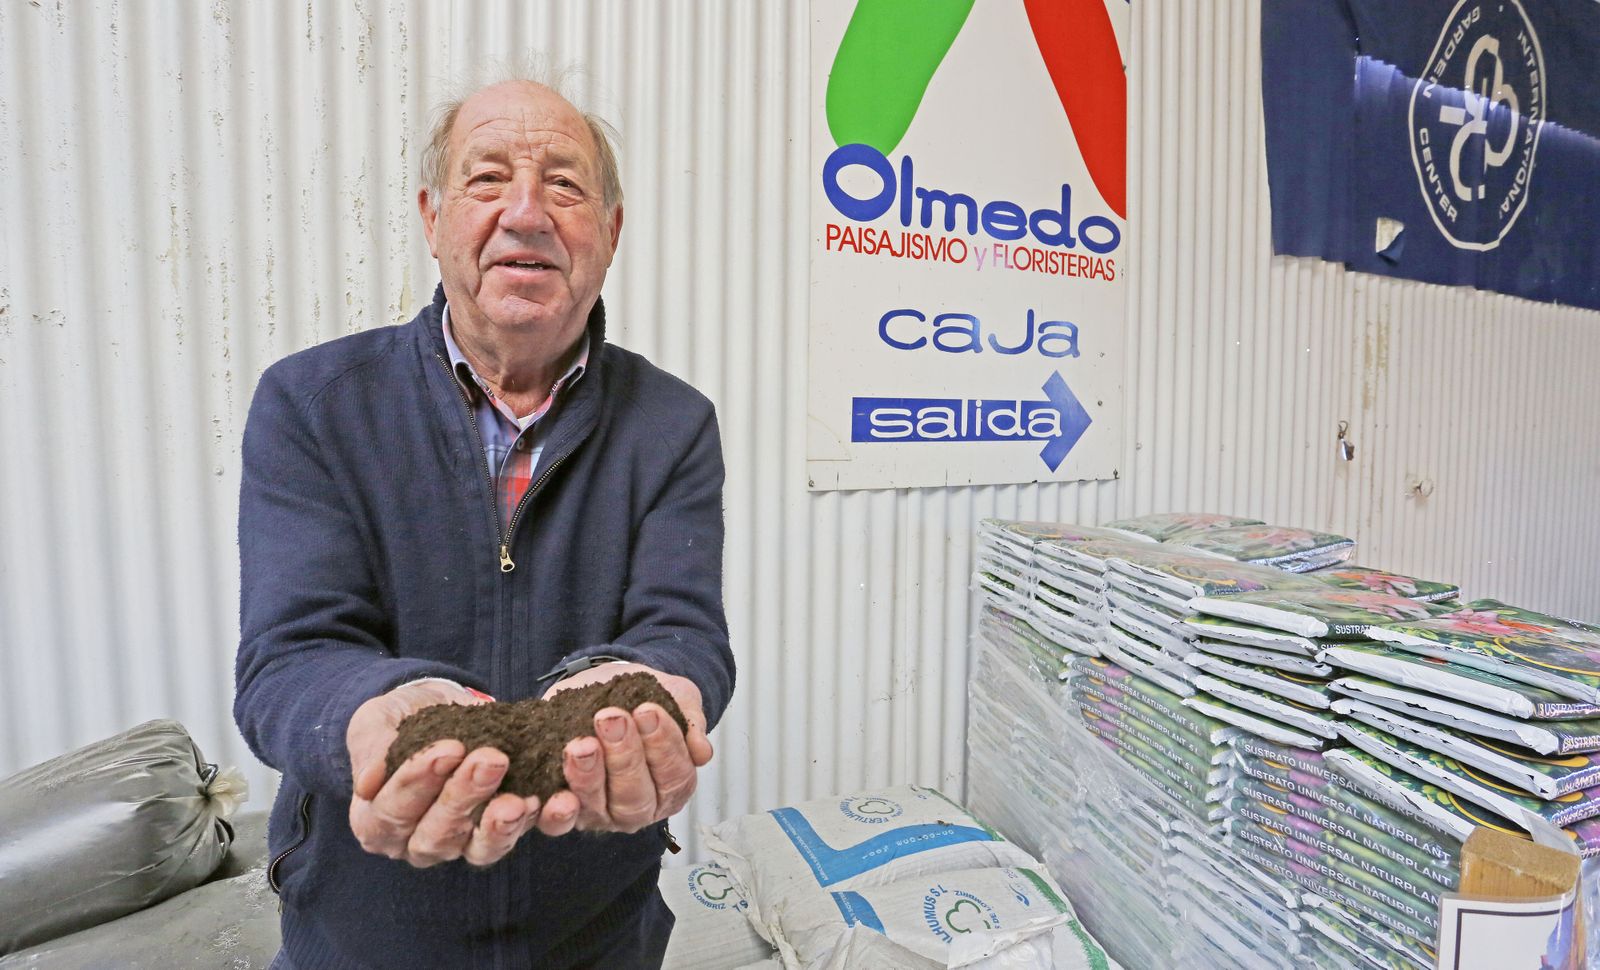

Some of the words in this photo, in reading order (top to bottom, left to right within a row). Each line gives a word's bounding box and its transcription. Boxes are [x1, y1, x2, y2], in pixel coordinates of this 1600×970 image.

[1423, 6, 1480, 98] GARDEN
[823, 143, 1121, 254] Olmedo
[1420, 127, 1458, 223] CENTER
[826, 224, 968, 263] PAISAJISMO
[973, 246, 987, 271] y
[993, 243, 1115, 282] FLORISTERIAS
[869, 399, 1062, 438] salida
[1141, 714, 1187, 745] NATURPLANT
[1142, 694, 1187, 725] NATURPLANT
[1137, 731, 1183, 760] NATURPLANT
[1244, 744, 1296, 767] SUSTRATO
[1298, 760, 1361, 794] UNIVERSAL
[1240, 808, 1293, 836] SUSTRATO
[1295, 830, 1360, 867] UNIVERSAL
[1242, 786, 1295, 813] SUSTRATO
[1297, 807, 1361, 843] UNIVERSAL
[1363, 837, 1452, 886] NATURPLANT
[1243, 766, 1295, 791] SUSTRATO
[1297, 785, 1361, 820] UNIVERSAL
[1363, 813, 1452, 861] NATURPLANT
[1240, 830, 1293, 858] SUSTRATO
[1295, 853, 1361, 890] UNIVERSAL
[1240, 848, 1294, 879] SUSTRATO
[694, 892, 726, 910] LOMBRIZ
